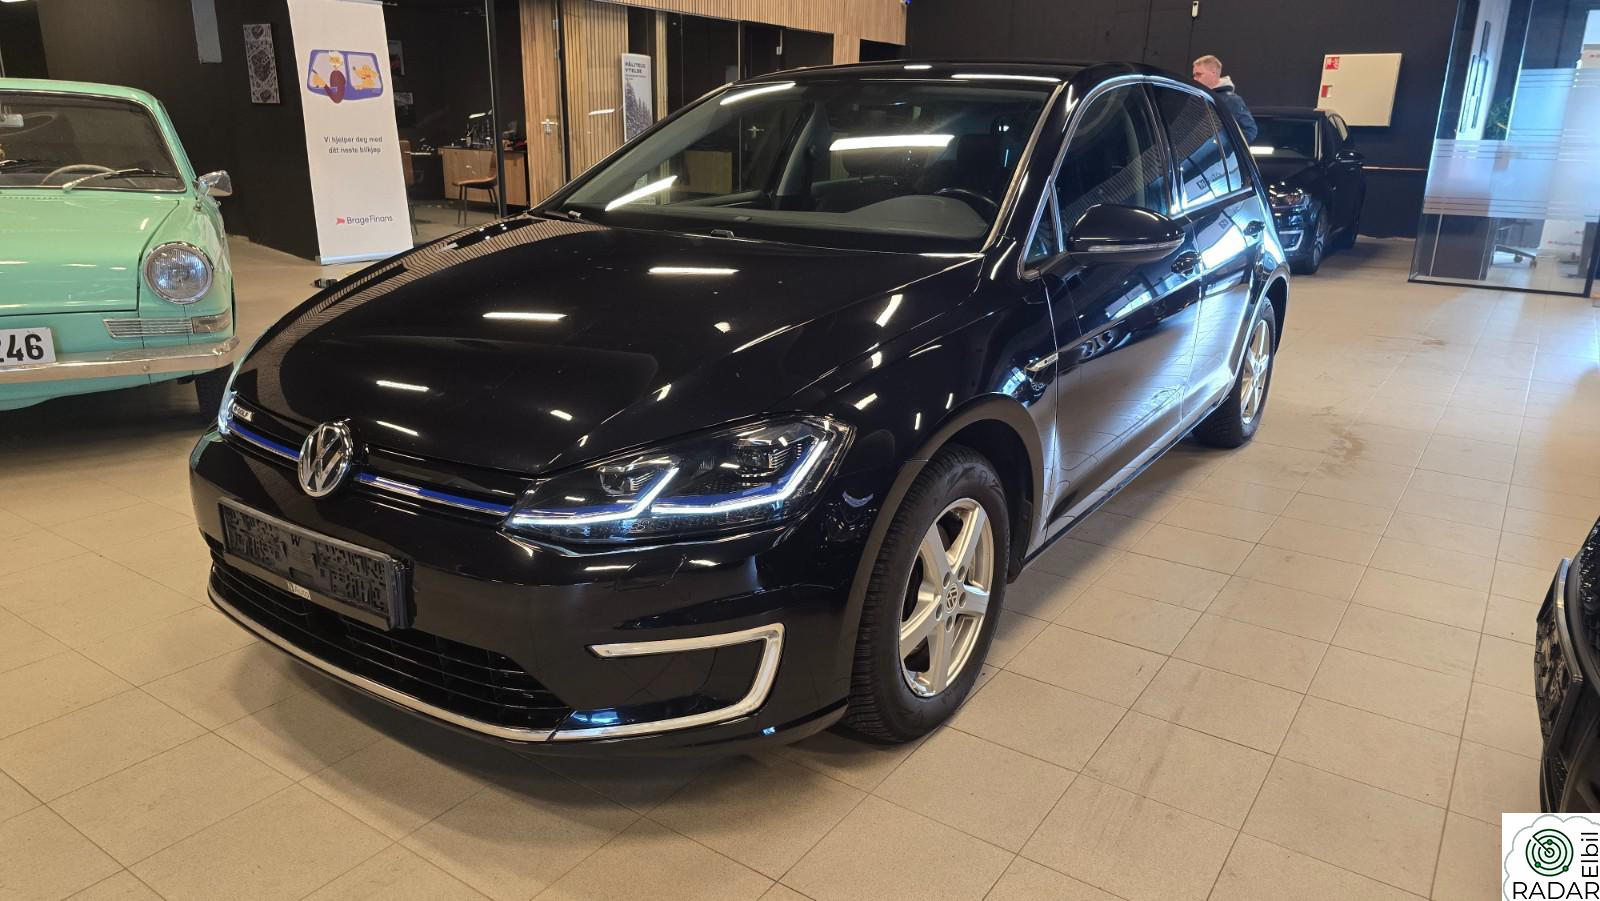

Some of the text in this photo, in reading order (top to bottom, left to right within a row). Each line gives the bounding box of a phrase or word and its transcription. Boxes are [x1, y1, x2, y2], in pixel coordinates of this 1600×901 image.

[331, 136, 354, 144] hjelper
[355, 136, 368, 144] deg
[0, 333, 44, 363] 46
